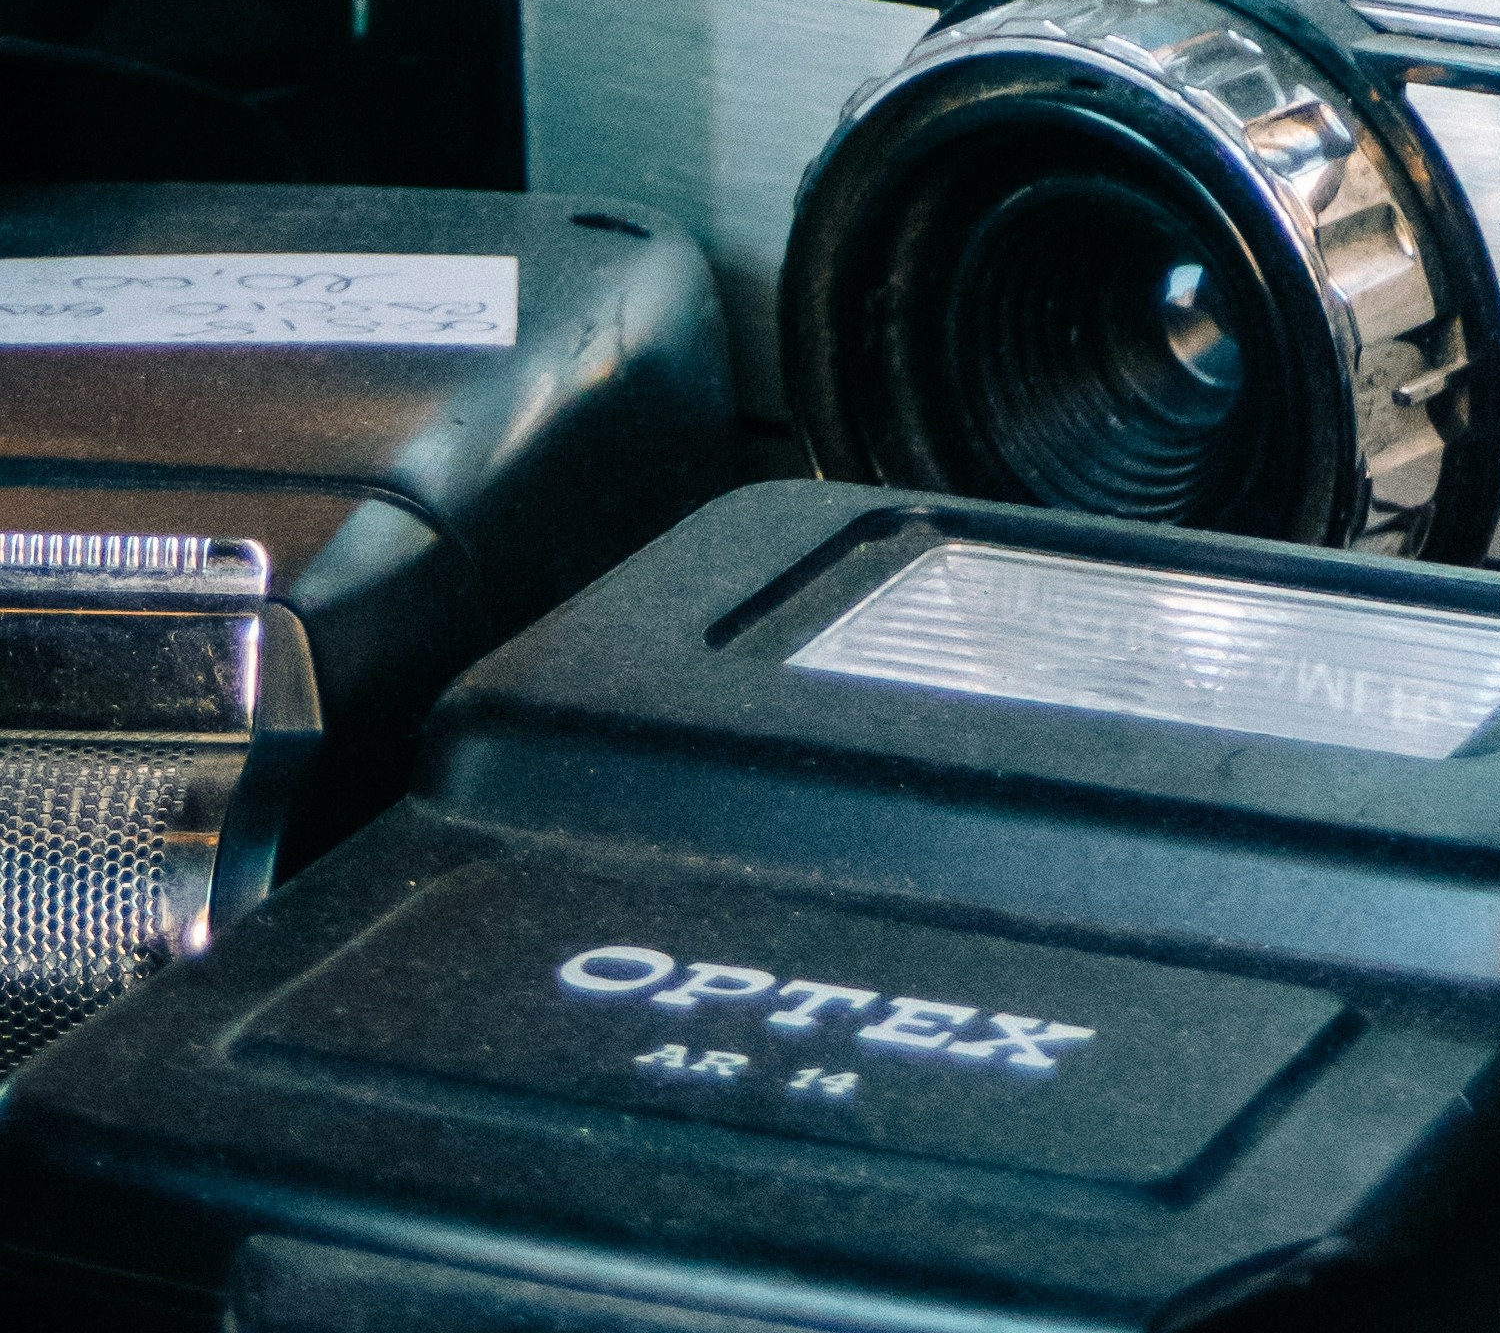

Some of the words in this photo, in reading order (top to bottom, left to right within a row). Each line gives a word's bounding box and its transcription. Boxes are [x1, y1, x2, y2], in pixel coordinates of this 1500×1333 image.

[559, 944, 1097, 1069] OPTEX
[633, 1043, 751, 1078] AR
[787, 1066, 861, 1097] 14
